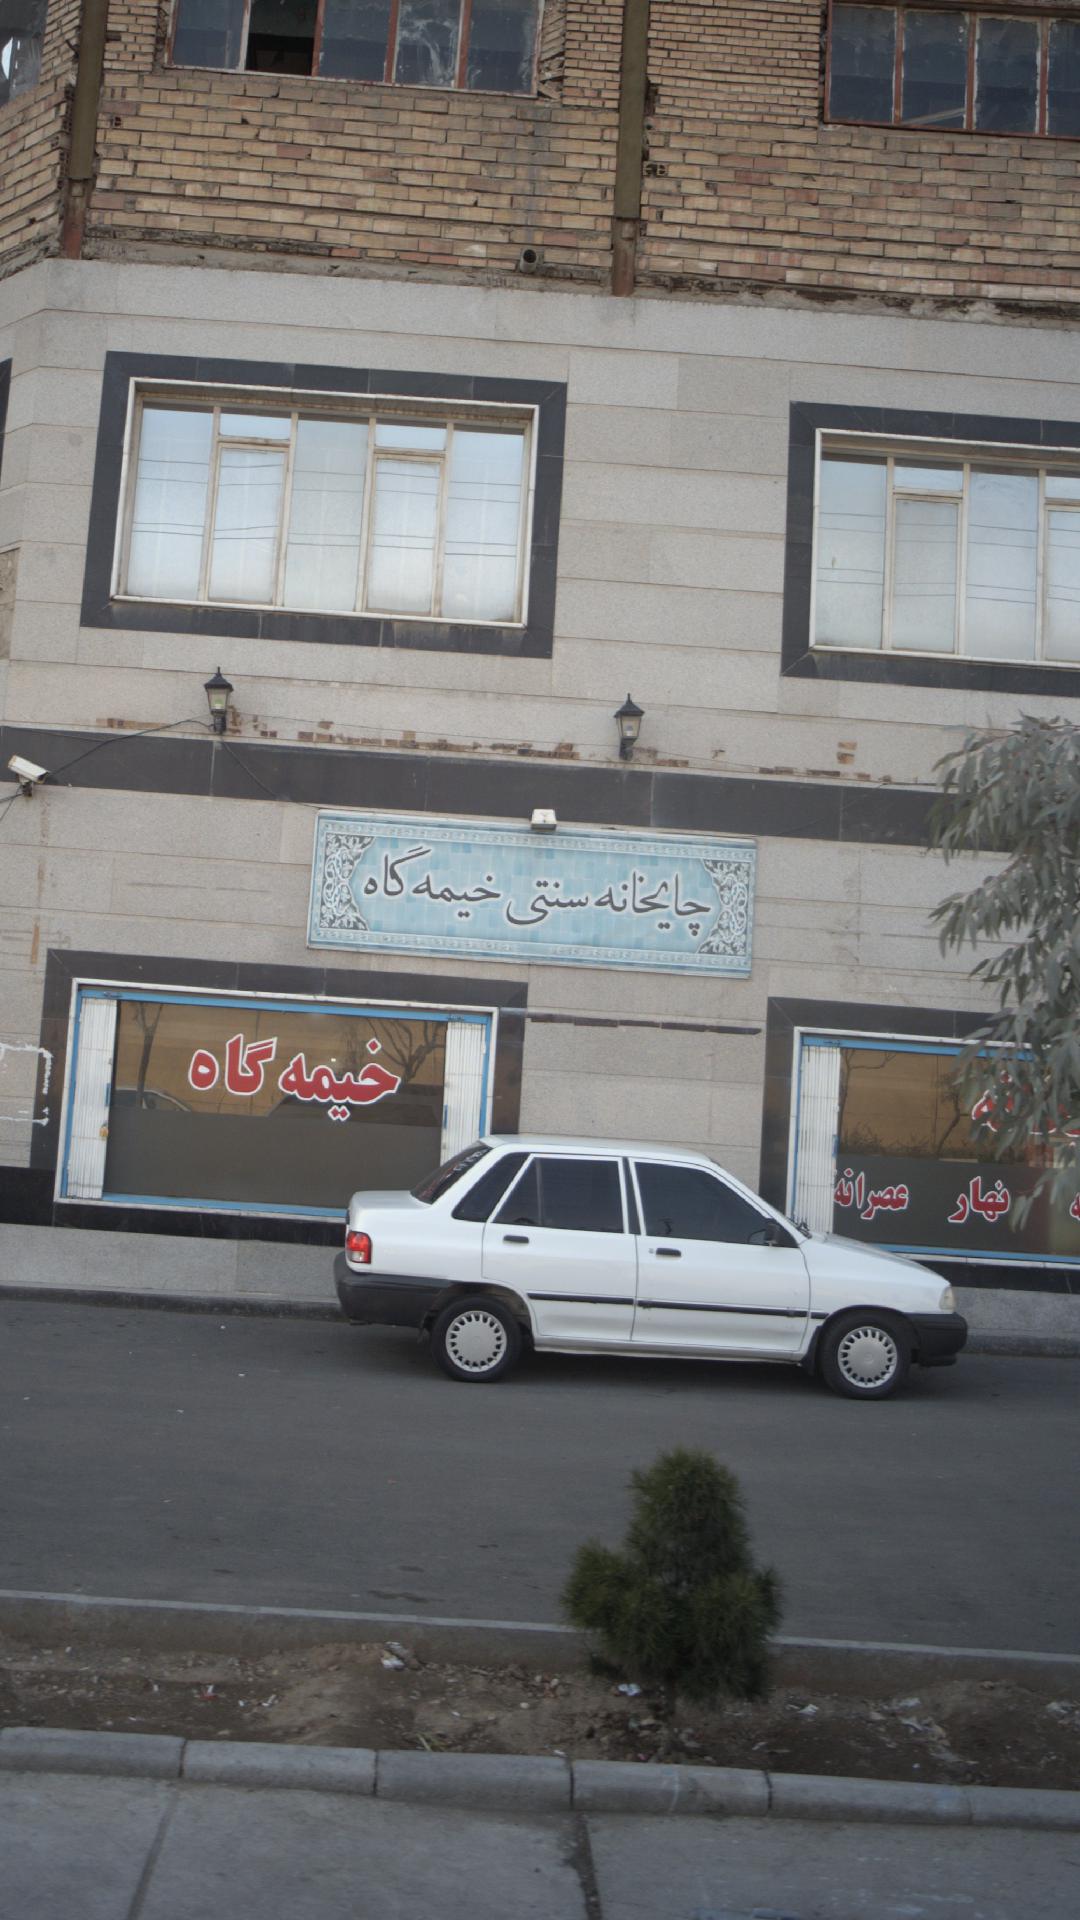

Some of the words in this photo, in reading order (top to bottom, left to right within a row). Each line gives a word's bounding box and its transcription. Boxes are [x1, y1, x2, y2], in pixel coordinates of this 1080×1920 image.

[506, 880, 589, 926] سنتی
[594, 870, 712, 937] چایخانه
[833, 1167, 909, 1220] عصرانه
[947, 1176, 1010, 1223] نهار
